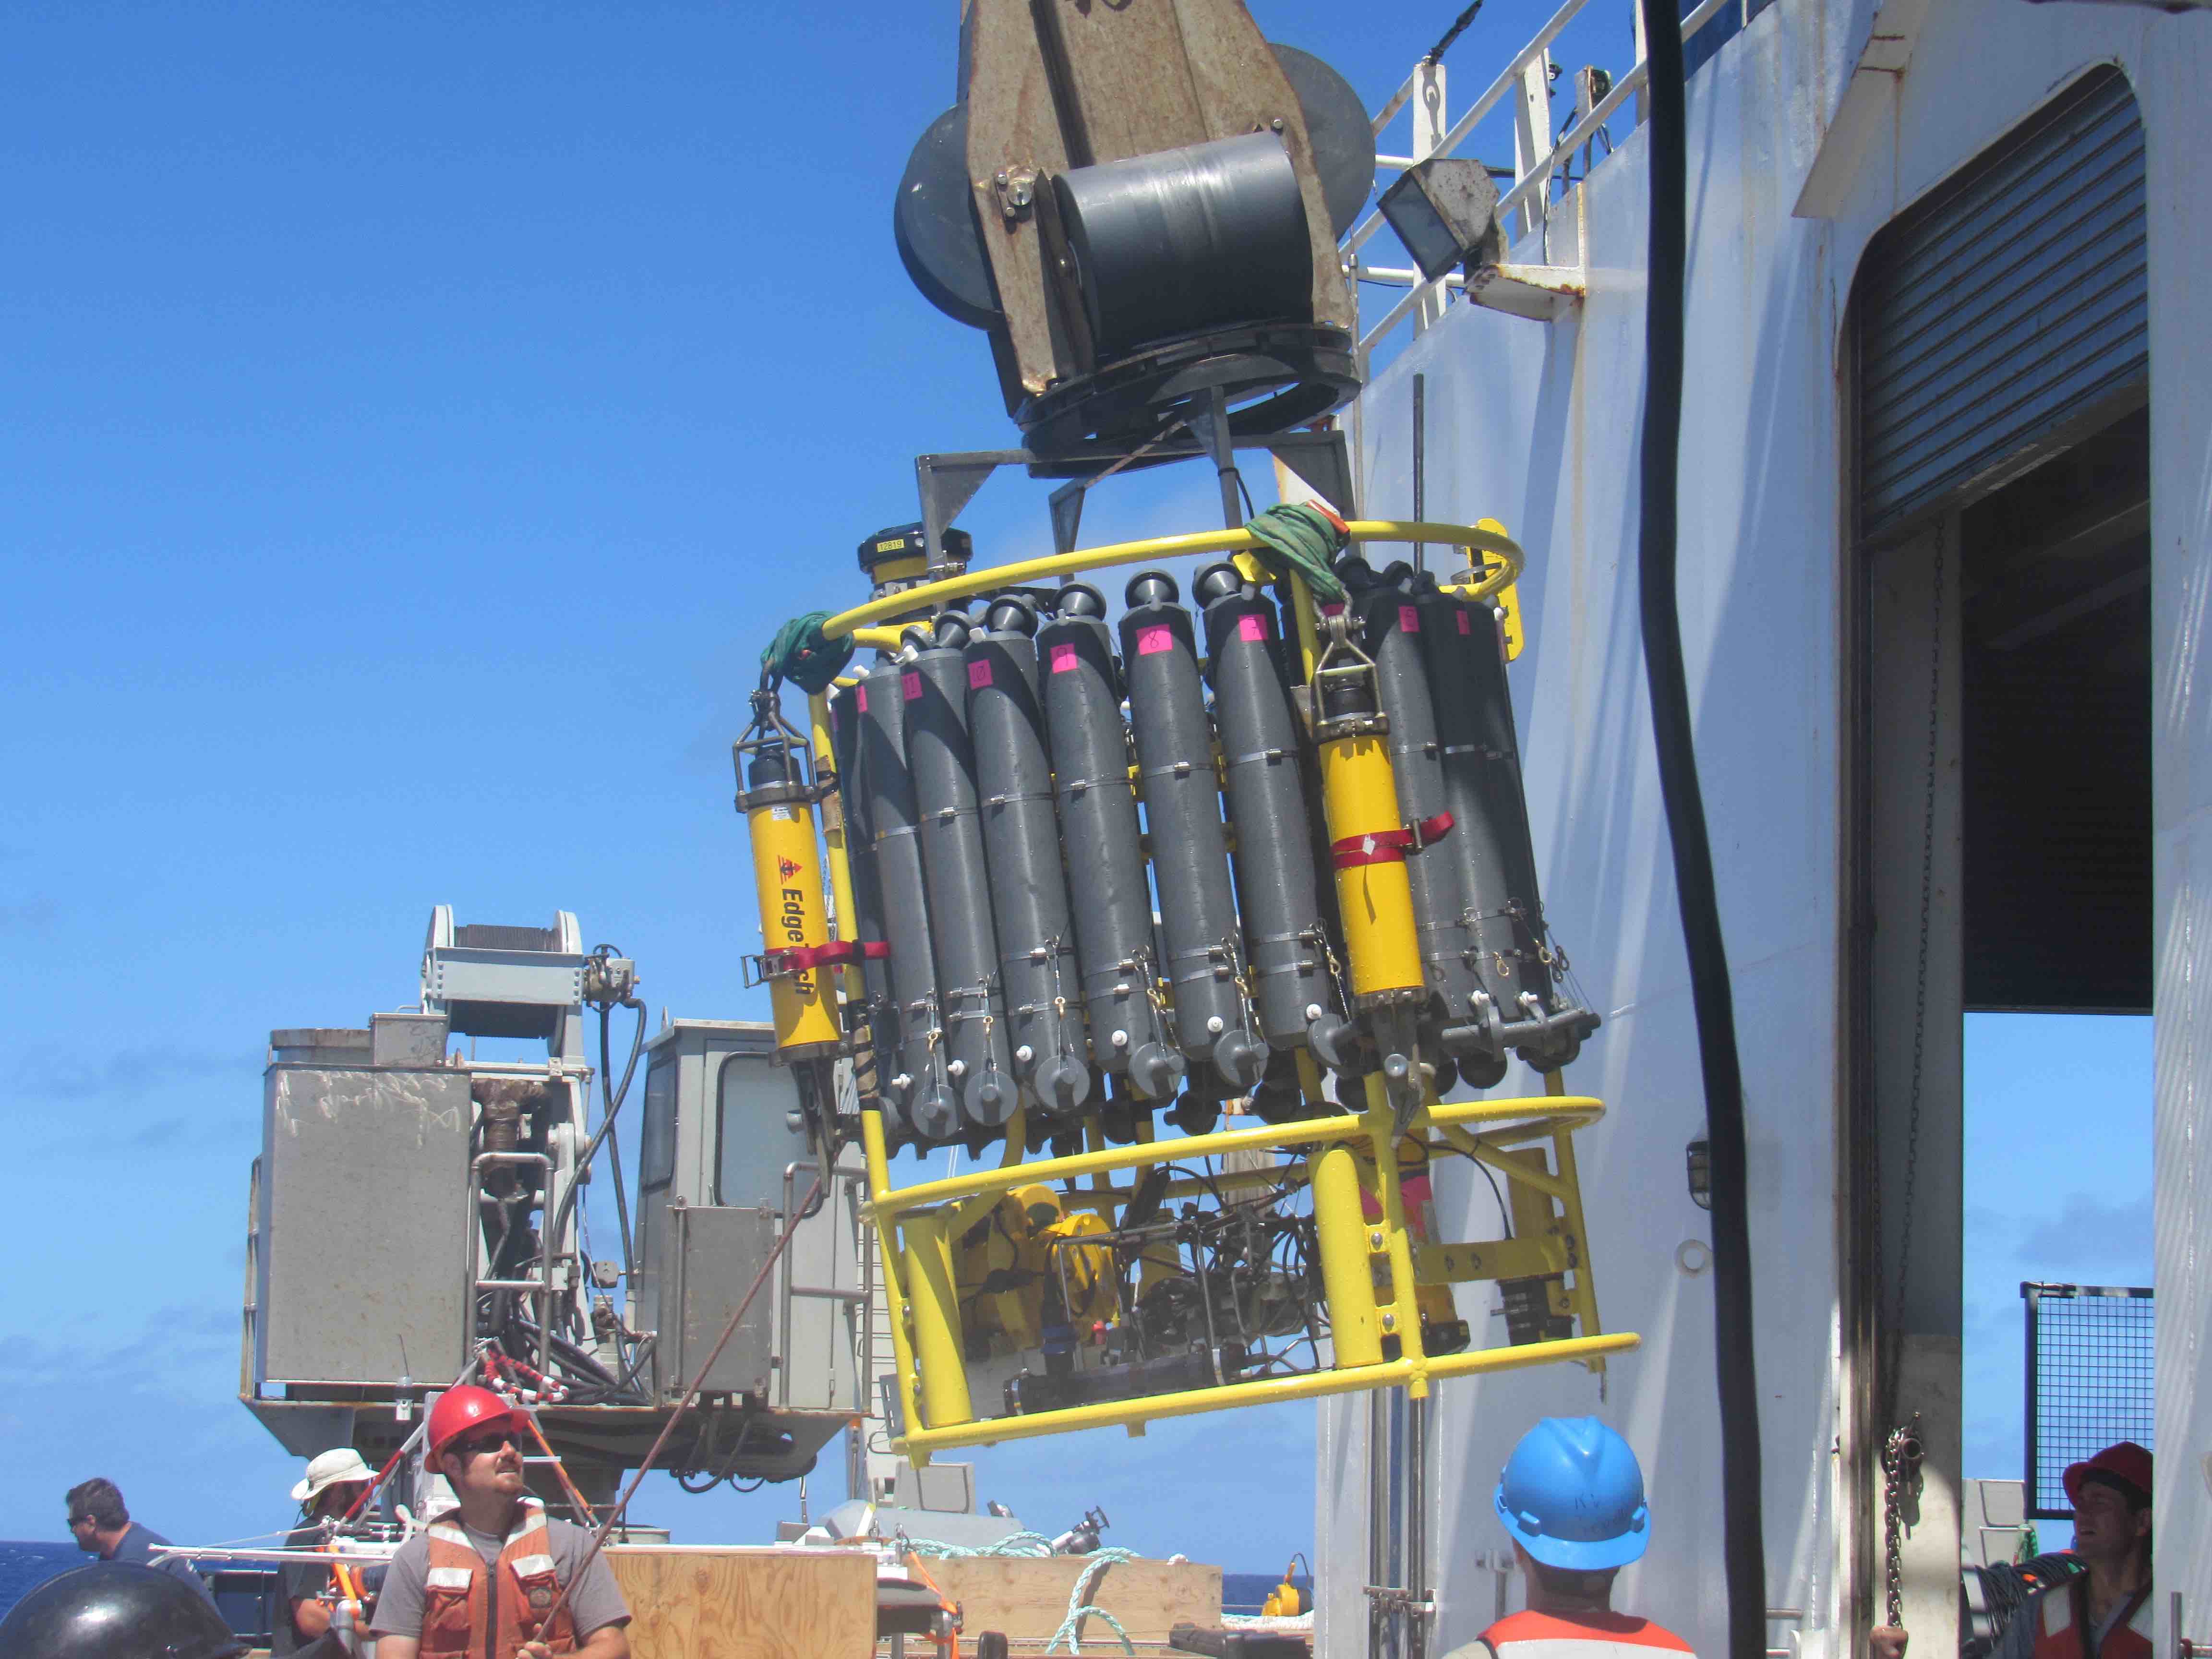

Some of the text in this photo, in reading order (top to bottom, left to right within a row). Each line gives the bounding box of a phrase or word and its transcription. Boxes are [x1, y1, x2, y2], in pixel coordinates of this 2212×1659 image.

[878, 540, 902, 552] 12819
[1148, 628, 1159, 649] 8
[1056, 647, 1068, 667] 9
[781, 888, 815, 995] Edgech
